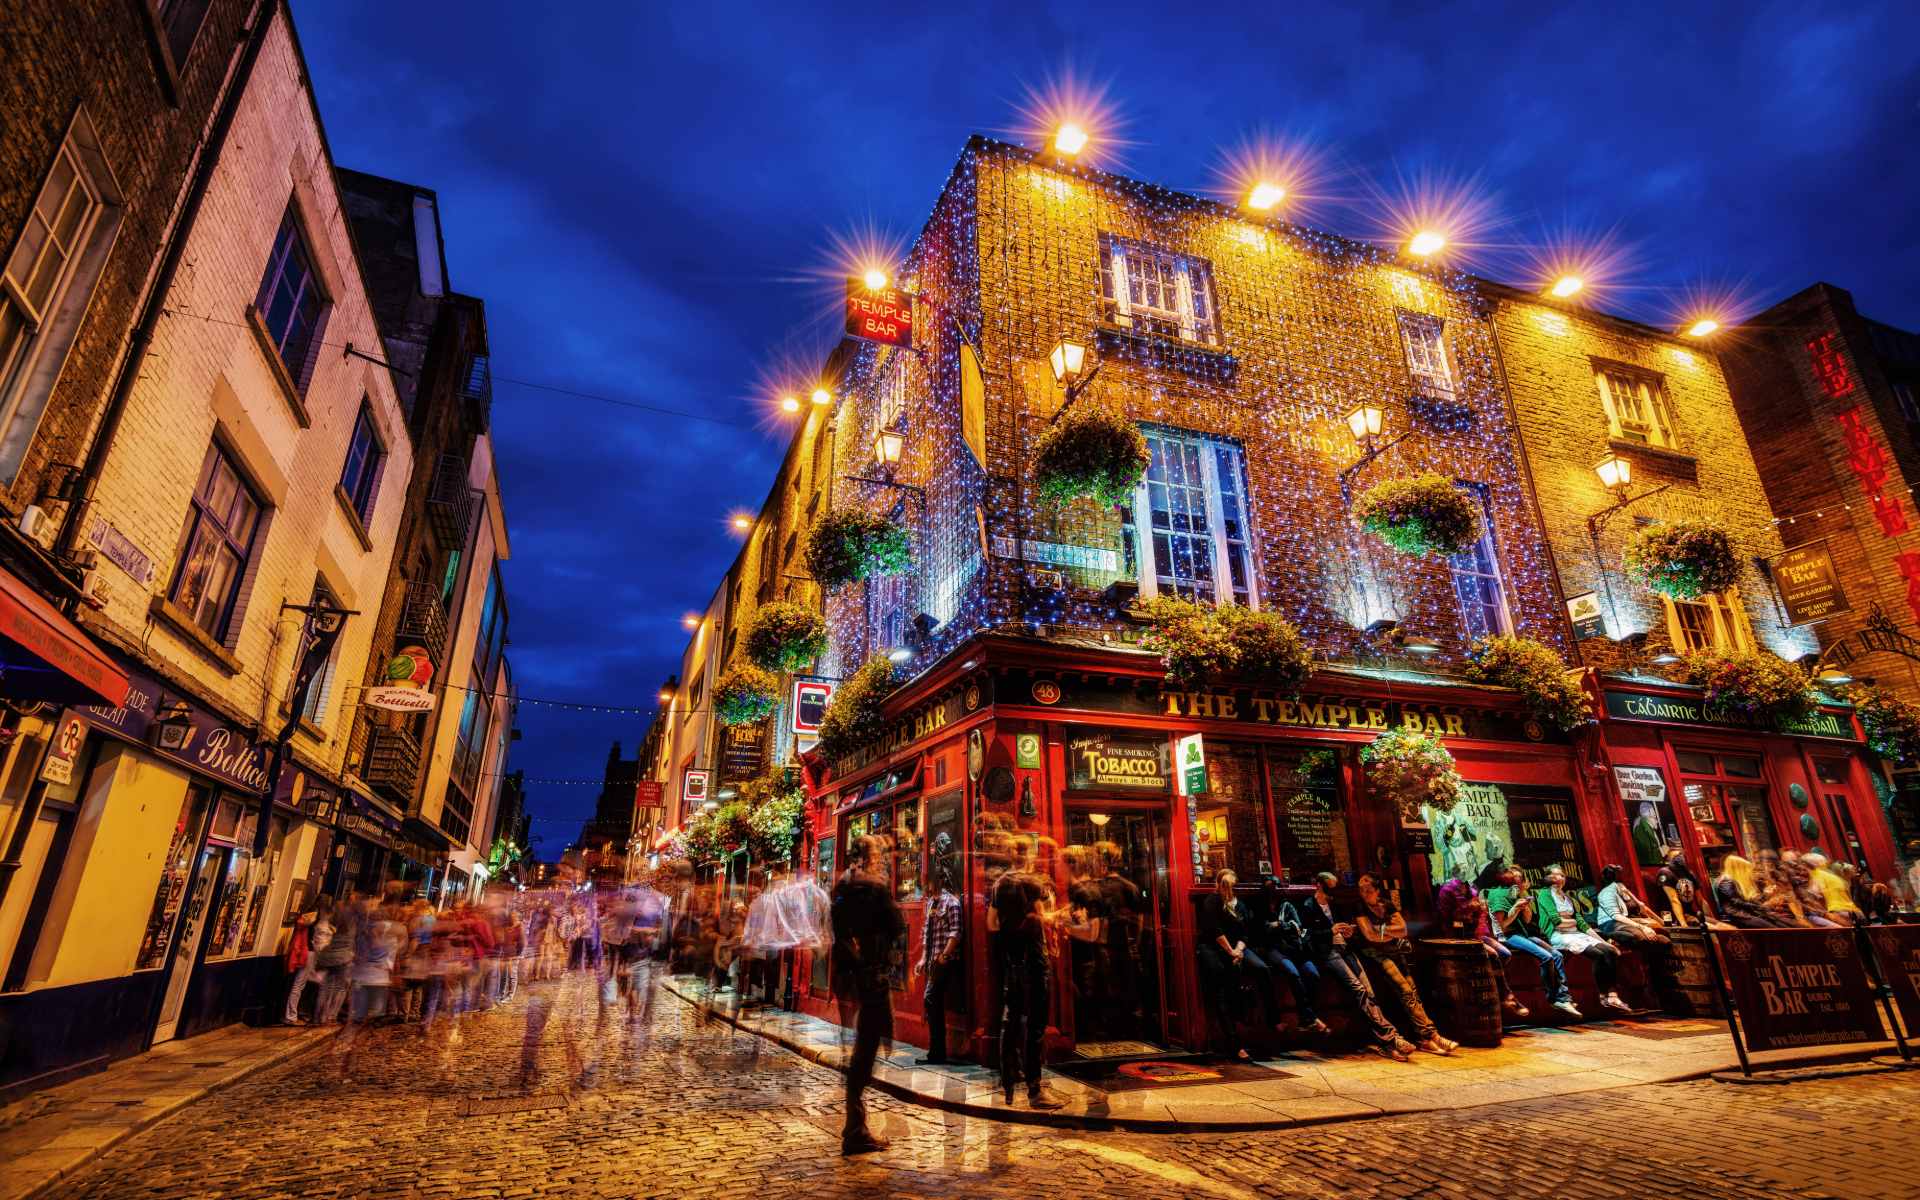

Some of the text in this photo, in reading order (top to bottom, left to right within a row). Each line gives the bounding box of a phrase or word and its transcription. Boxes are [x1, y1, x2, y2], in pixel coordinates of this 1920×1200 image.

[851, 297, 911, 323] TEMPLE
[866, 318, 897, 337] BAR
[1790, 552, 1806, 561] THE
[1778, 557, 1826, 576] TEMPLE
[1792, 571, 1818, 584] BAR
[1806, 584, 1833, 595] GARDEN
[1797, 600, 1834, 614] LIVE MUSIC
[1808, 607, 1827, 616] DAILY
[1037, 684, 1055, 698] 48
[373, 694, 431, 709] Botticelli
[1161, 691, 1467, 736] THE TEMPLE BAR
[837, 752, 857, 777] THE
[914, 704, 947, 740] BAR
[198, 728, 274, 793] Bottice
[1107, 747, 1155, 758] FINE SMOKING
[1082, 751, 1157, 780] TOBACCO
[1097, 774, 1128, 784] Always
[1141, 777, 1164, 786] Stock
[1631, 771, 1654, 781] Garden
[1619, 780, 1645, 791] Smoking
[1286, 793, 1330, 810] TEMPLE BAR
[1458, 791, 1503, 805] EMPLE
[1466, 803, 1495, 819] BAR
[1543, 804, 1568, 821] THE
[1521, 822, 1572, 840] EMPEROR
[1562, 843, 1575, 859] OF
[1755, 955, 1841, 988] THE TEMPLE
[1760, 981, 1809, 1015] BAR
